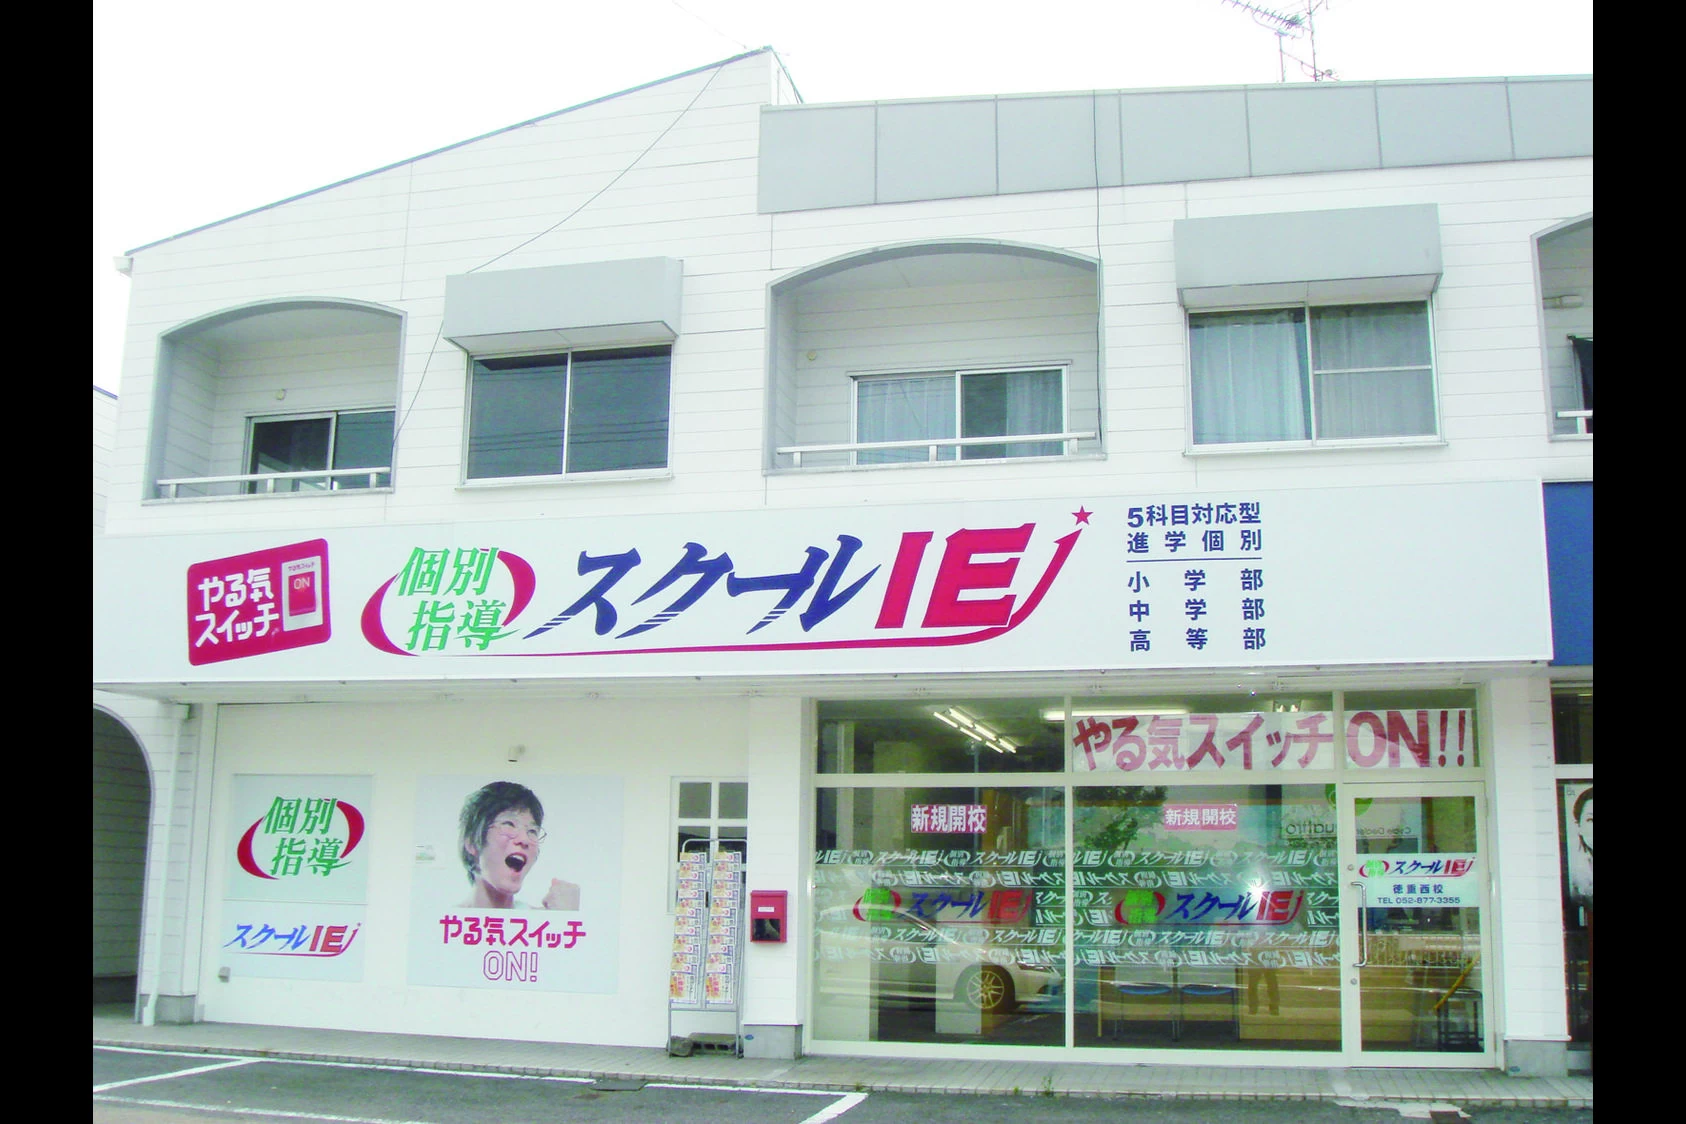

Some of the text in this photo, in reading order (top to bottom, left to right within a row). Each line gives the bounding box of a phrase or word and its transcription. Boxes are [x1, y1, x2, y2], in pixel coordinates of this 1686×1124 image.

[1127, 502, 1261, 528] 5科目対応型
[1127, 529, 1262, 553] 進学個別
[293, 577, 311, 590] ON
[397, 546, 499, 597] 個別
[1127, 568, 1264, 593] 小学部
[198, 567, 275, 611] やる気
[195, 602, 280, 648] スイッチ
[1129, 598, 1265, 623] 中学部
[406, 599, 520, 652] 指導
[1129, 627, 1266, 652] 高等部
[1073, 710, 1468, 771] やる気スイッチ ON!!
[264, 796, 338, 836] 個別
[911, 804, 987, 833] 新規開校
[1165, 808, 1237, 826] 新規開校
[270, 837, 351, 877] 指導
[1393, 883, 1443, 894] 徳重西校
[1396, 896, 1461, 904] 052-877-3355
[439, 914, 587, 949] やる気スイッチ
[483, 951, 539, 982] ON!
